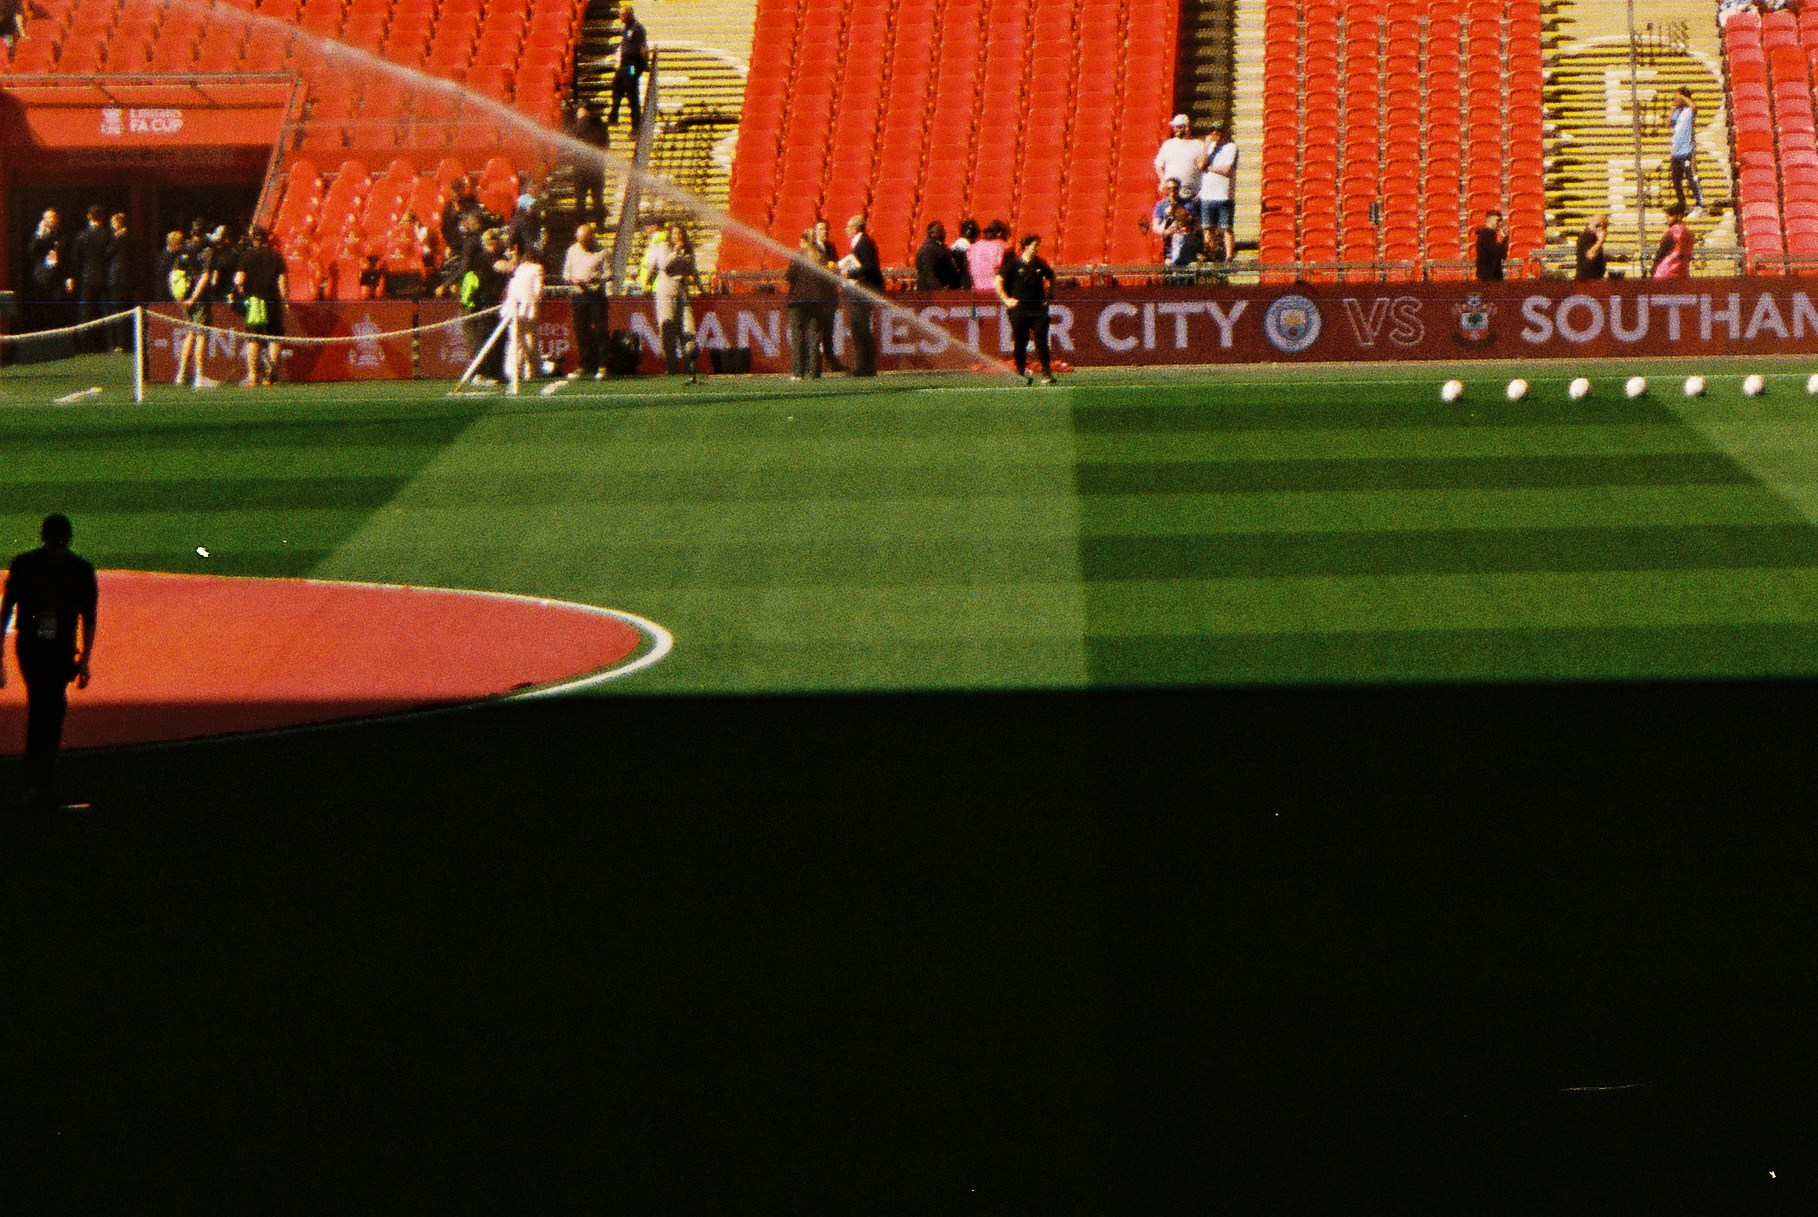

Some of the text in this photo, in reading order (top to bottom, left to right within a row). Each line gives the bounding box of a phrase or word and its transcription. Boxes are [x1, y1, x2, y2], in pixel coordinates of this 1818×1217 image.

[151, 119, 184, 133] CUP
[1097, 300, 1249, 352] CITY
[1343, 296, 1425, 348] VS
